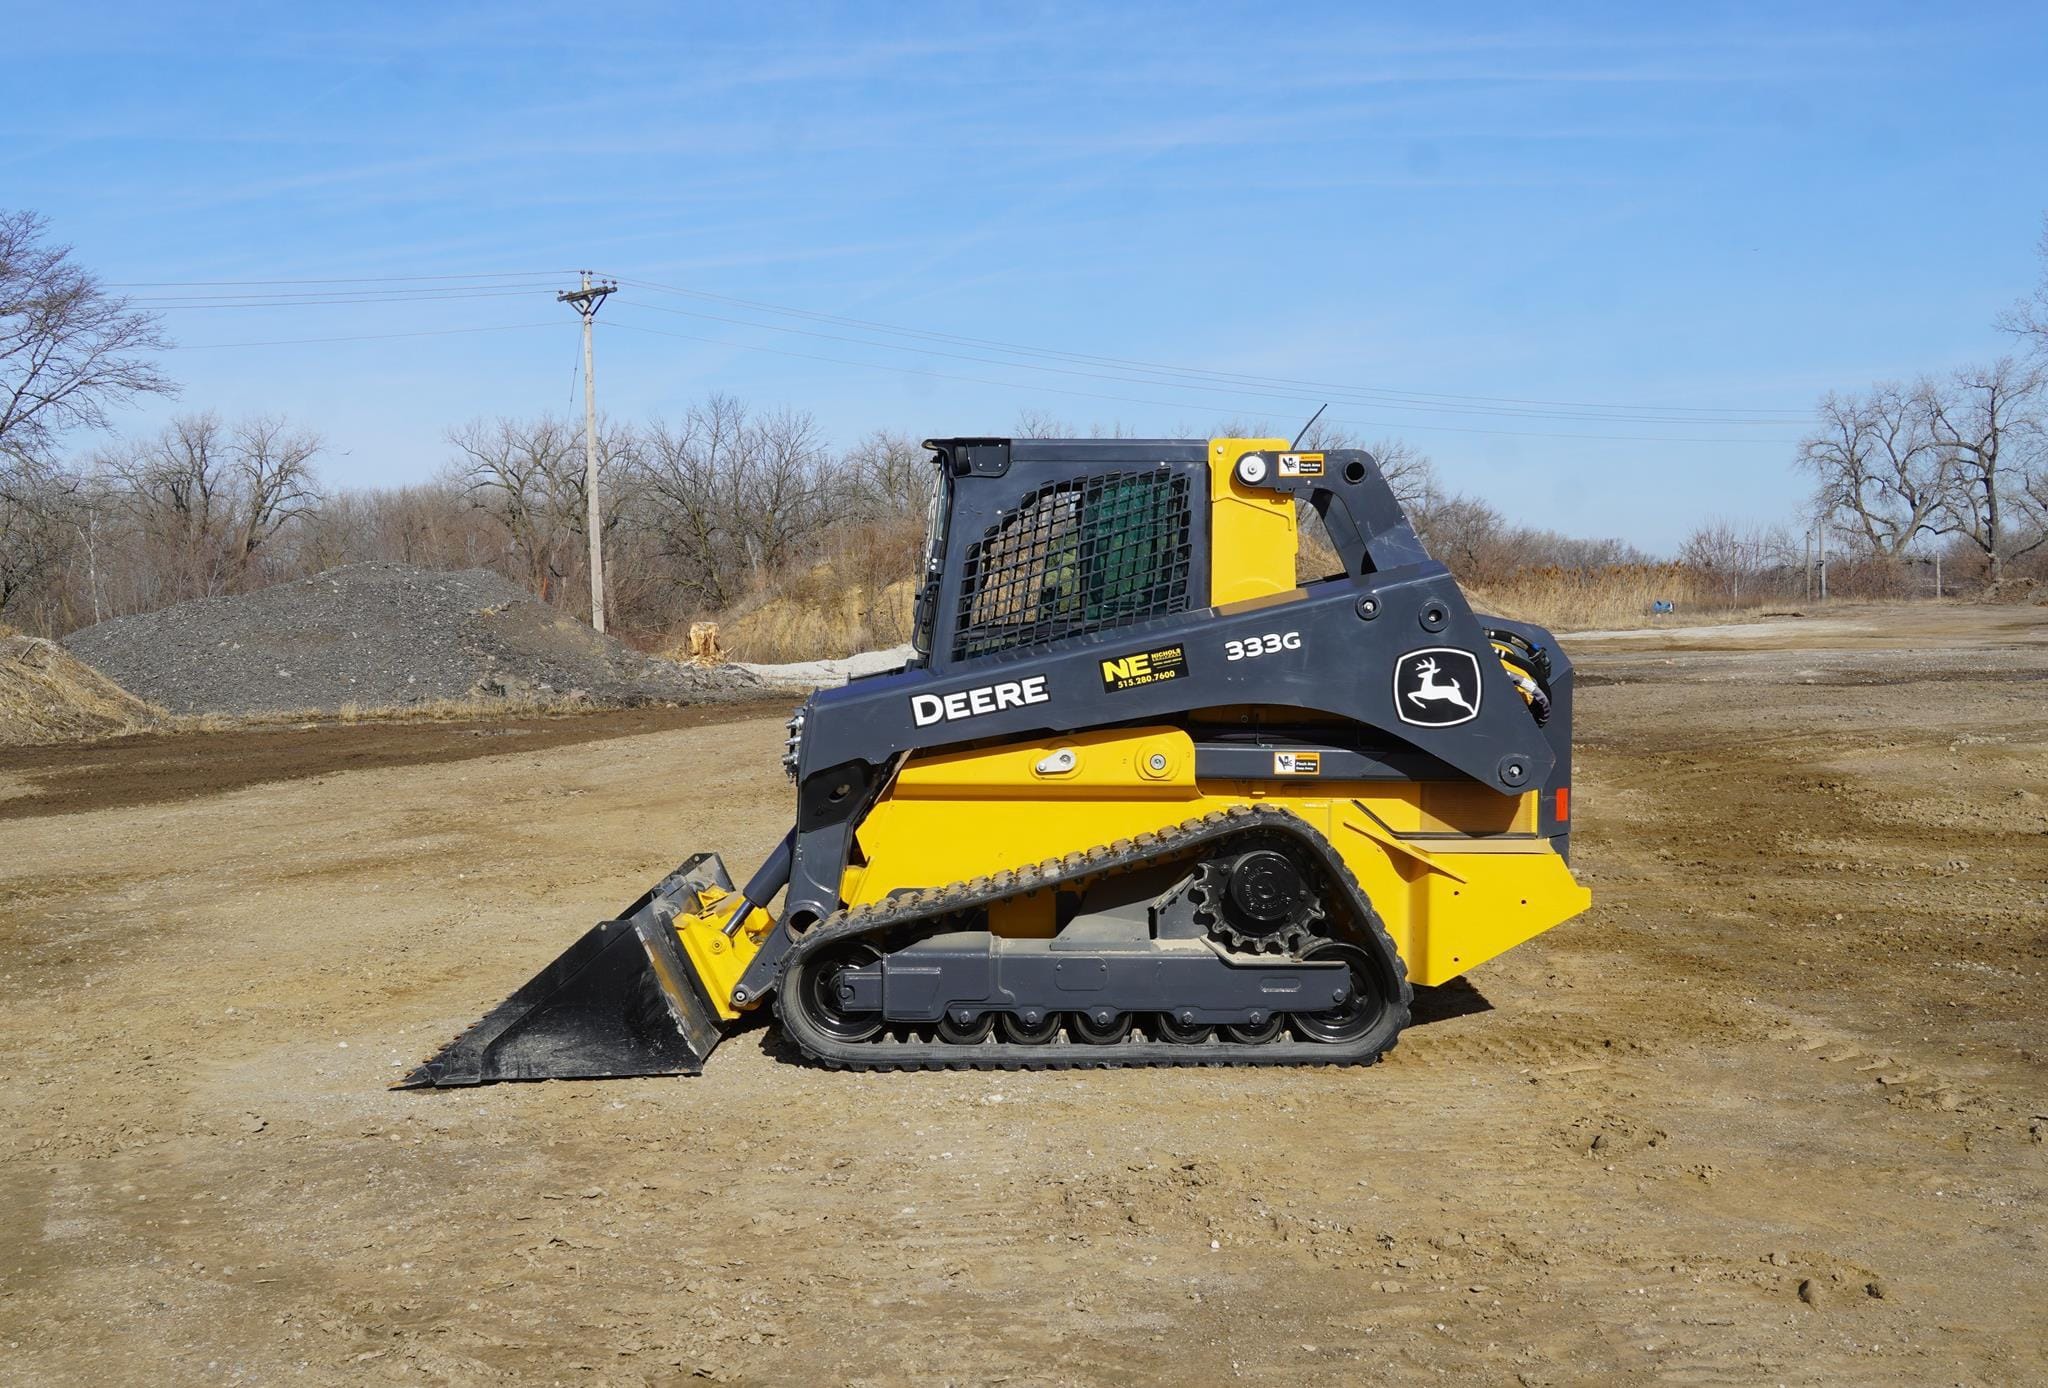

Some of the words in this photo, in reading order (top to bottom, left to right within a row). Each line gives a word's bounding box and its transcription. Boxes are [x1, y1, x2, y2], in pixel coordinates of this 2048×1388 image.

[1225, 632, 1301, 661] 333G
[1102, 654, 1152, 682] NE
[1117, 670, 1175, 689] 515.280.7600
[911, 676, 1049, 727] DEERE
